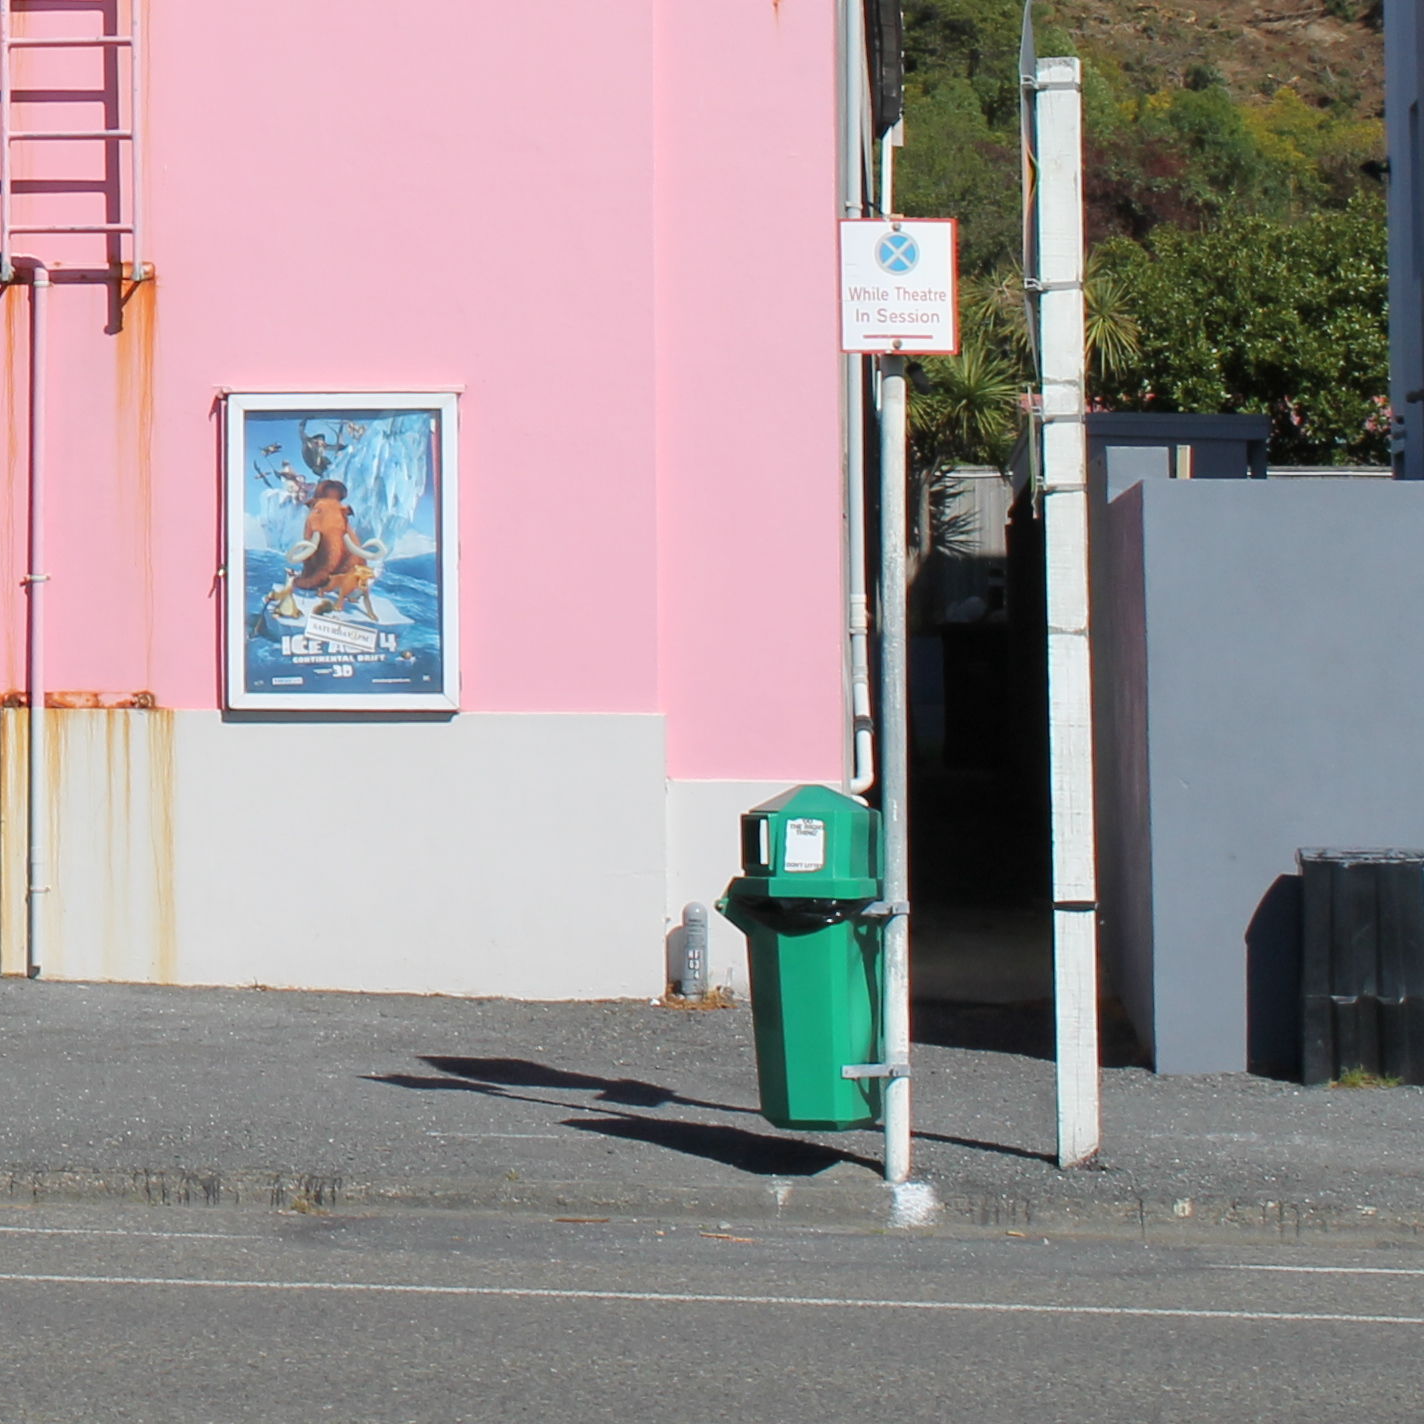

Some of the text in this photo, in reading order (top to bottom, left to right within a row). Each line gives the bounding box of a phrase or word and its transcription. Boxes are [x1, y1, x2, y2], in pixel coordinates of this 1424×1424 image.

[849, 286, 947, 302] While Theatre
[856, 309, 940, 324] In Session
[281, 635, 323, 656] ICE
[379, 632, 397, 652] 4
[292, 654, 386, 664] CONTINENTAL DRIFT
[332, 664, 353, 678] 3D
